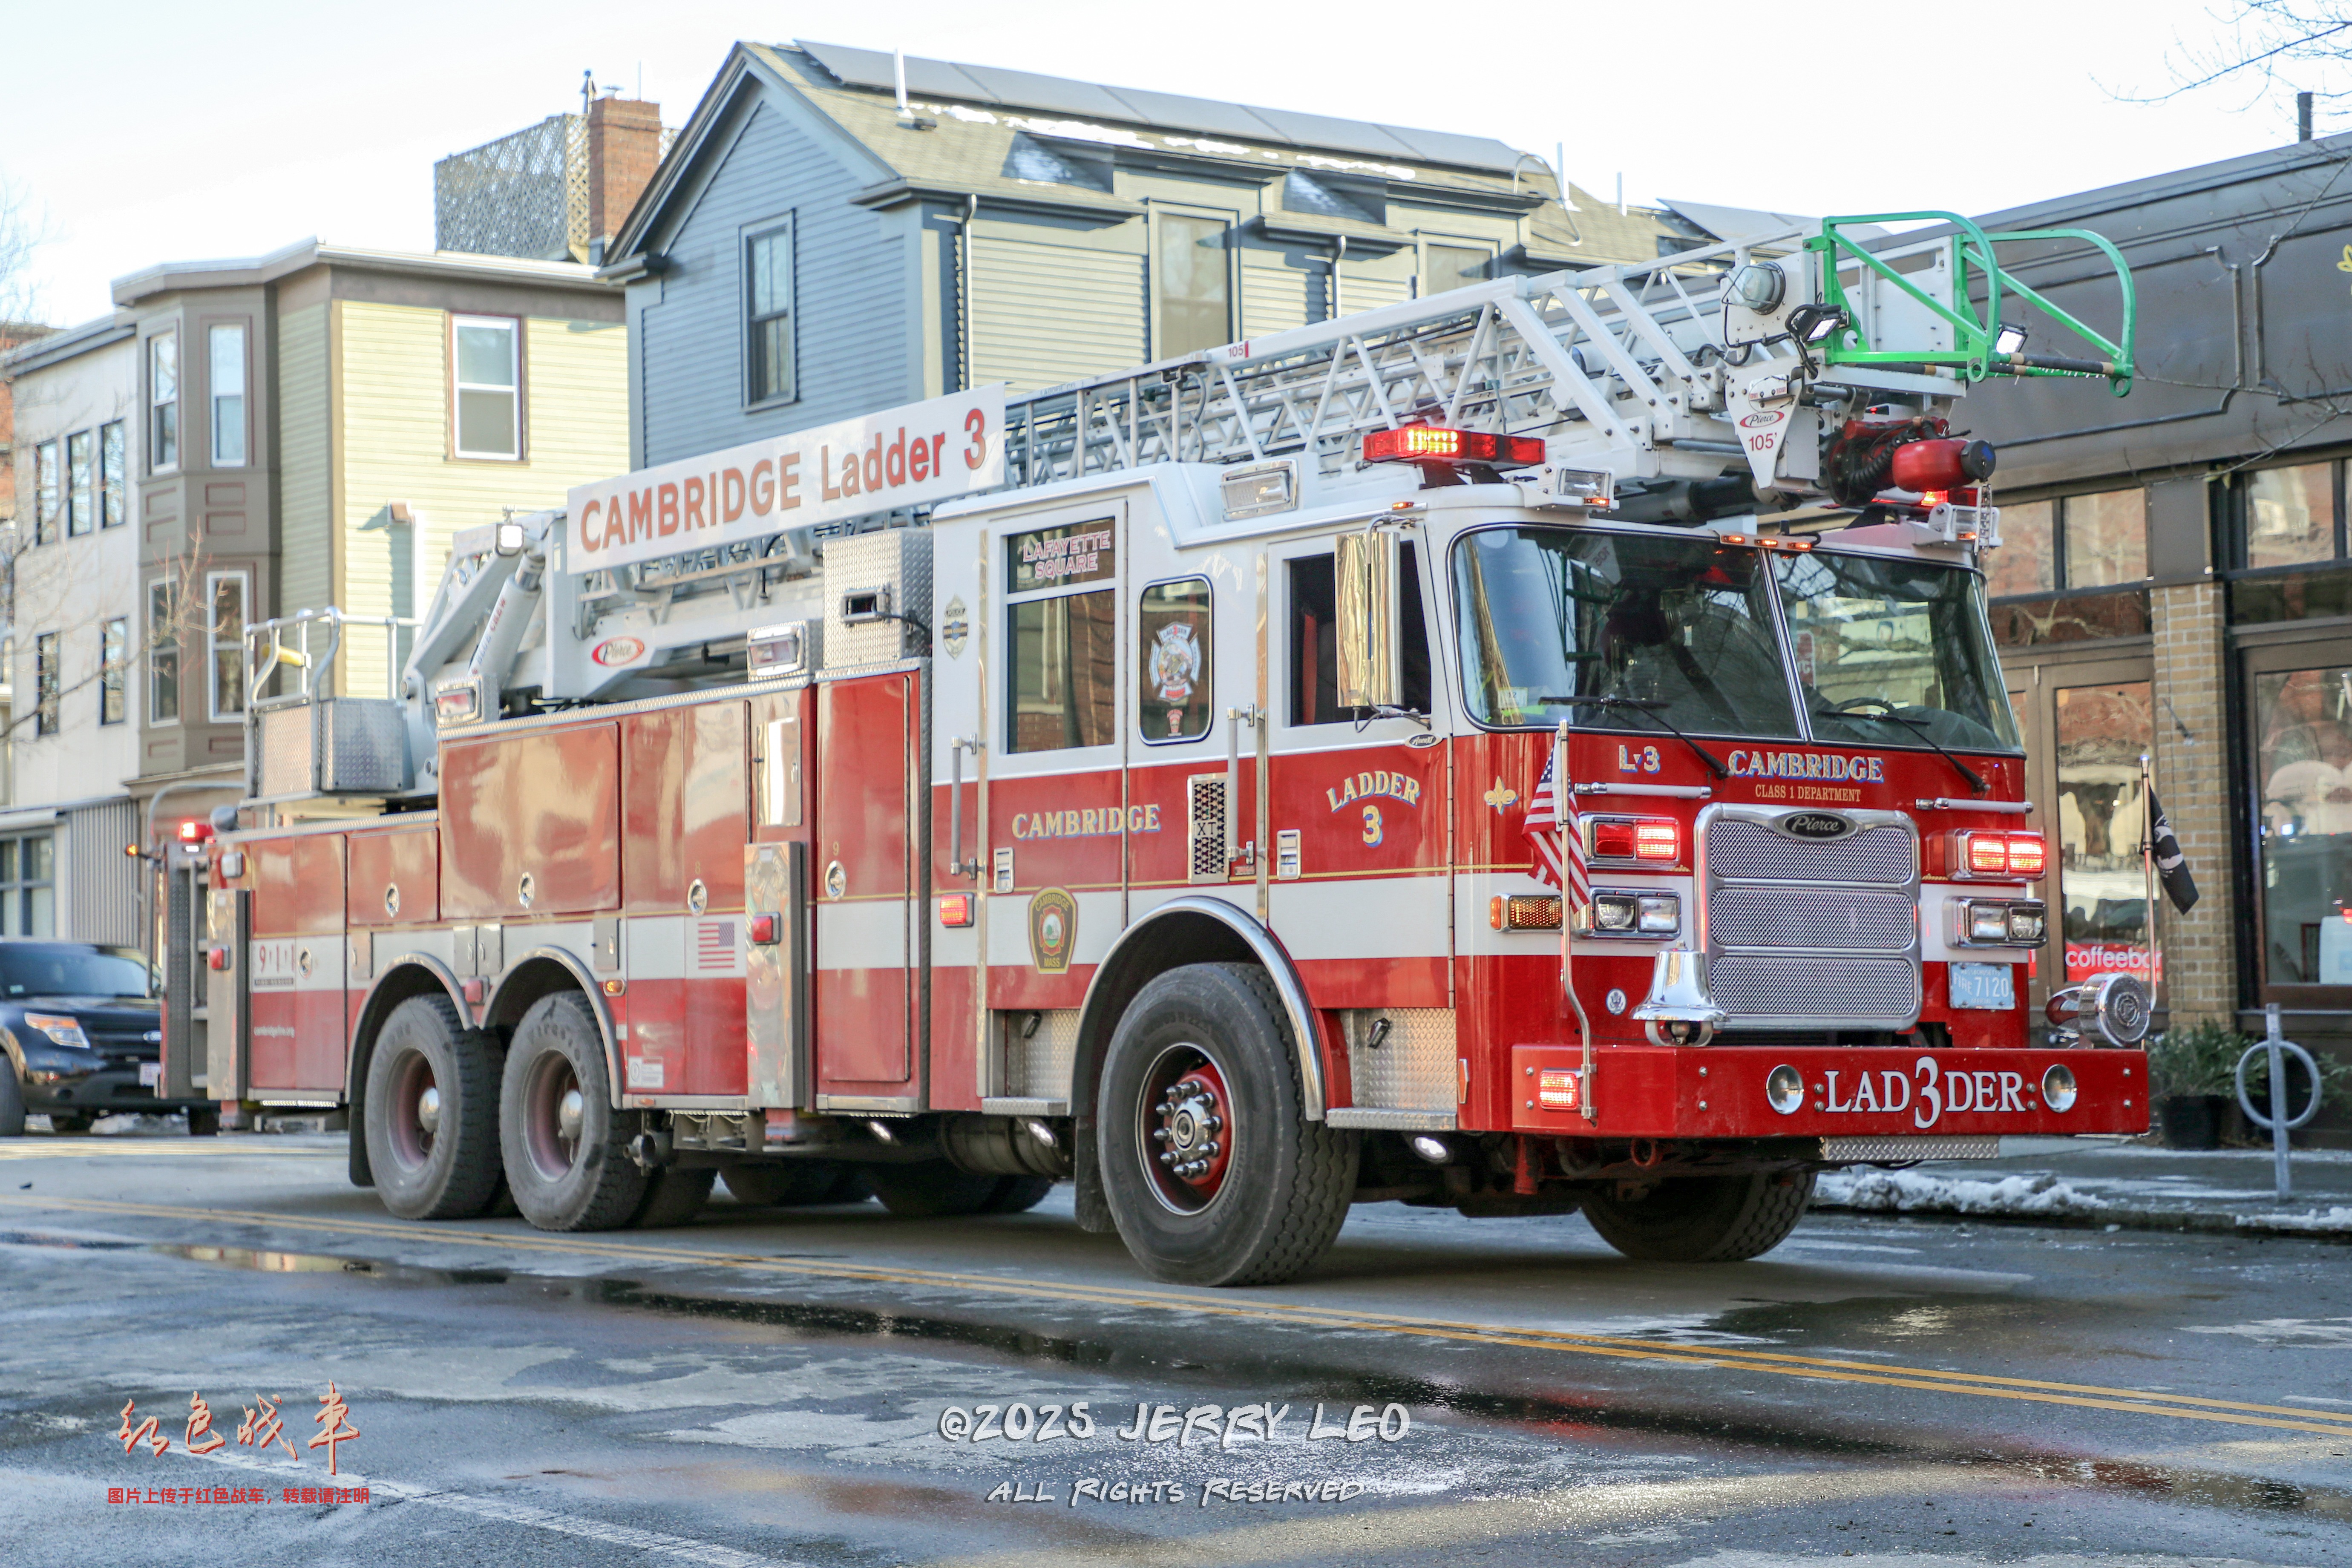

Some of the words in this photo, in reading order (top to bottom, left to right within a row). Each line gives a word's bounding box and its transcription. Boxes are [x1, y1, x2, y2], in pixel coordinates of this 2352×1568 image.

[1228, 344, 1244, 357] 105
[1750, 414, 1774, 426] Pierce
[1749, 432, 1777, 451] 105'
[580, 452, 801, 552] CAMBRIDGE
[821, 427, 945, 502] Ladder
[964, 408, 986, 470] 3
[1023, 529, 1111, 563] LAFAYETTE
[1035, 551, 1098, 580] SQUARE
[1728, 749, 1884, 783] CAMBRIDGE
[1326, 770, 1421, 812] LADDER
[1755, 784, 1786, 799] CLASS
[1790, 785, 1795, 799] 1
[1797, 786, 1861, 803] DEPARTMENT
[1011, 804, 1160, 840] CAMBRIDGE
[1362, 805, 1382, 848] 3
[1789, 814, 1840, 834] Pierce
[833, 841, 840, 857] 9
[1035, 893, 1070, 912] CAMBRIDGE
[1044, 957, 1060, 968] MASS
[1974, 976, 2009, 998] 7120
